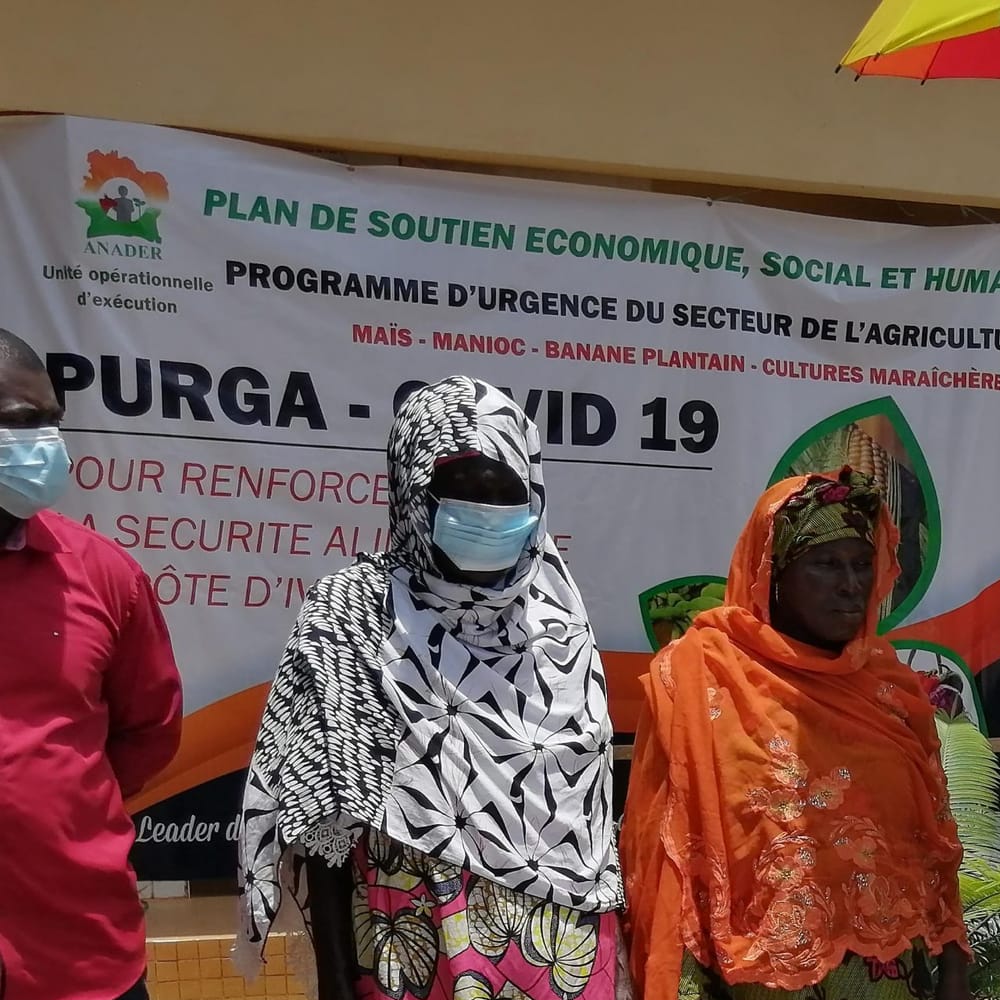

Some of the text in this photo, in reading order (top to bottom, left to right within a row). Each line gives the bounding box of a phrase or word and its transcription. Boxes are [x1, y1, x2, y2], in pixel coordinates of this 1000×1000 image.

[84, 240, 163, 260] ANADER
[203, 188, 298, 228] PLAN
[311, 203, 357, 234] DE
[367, 210, 516, 251] SOUTIEN
[525, 226, 750, 279] ECONOMIQUE,
[760, 250, 871, 288] SOCIAL
[880, 266, 917, 289] ET
[43, 264, 214, 292] Unité opérationnelle
[226, 260, 439, 304] PROGRAMME
[448, 284, 617, 321] D'URGENCE
[626, 298, 665, 324] DU
[673, 302, 792, 338] SECTEUR
[801, 316, 840, 341] DE
[352, 322, 413, 347] MAÏS
[432, 332, 526, 357] MANIOC
[545, 340, 636, 366] BANANE
[642, 348, 745, 373] PLANTAIN
[762, 358, 863, 385] CULTURES
[46, 352, 327, 431] PURGA
[393, 380, 617, 446] VID
[640, 396, 719, 454] 19
[69, 455, 389, 506] OUR RENFORCE
[114, 514, 313, 555] SECURITE
[152, 564, 232, 606] ÔTE
[135, 814, 220, 843] Leader
